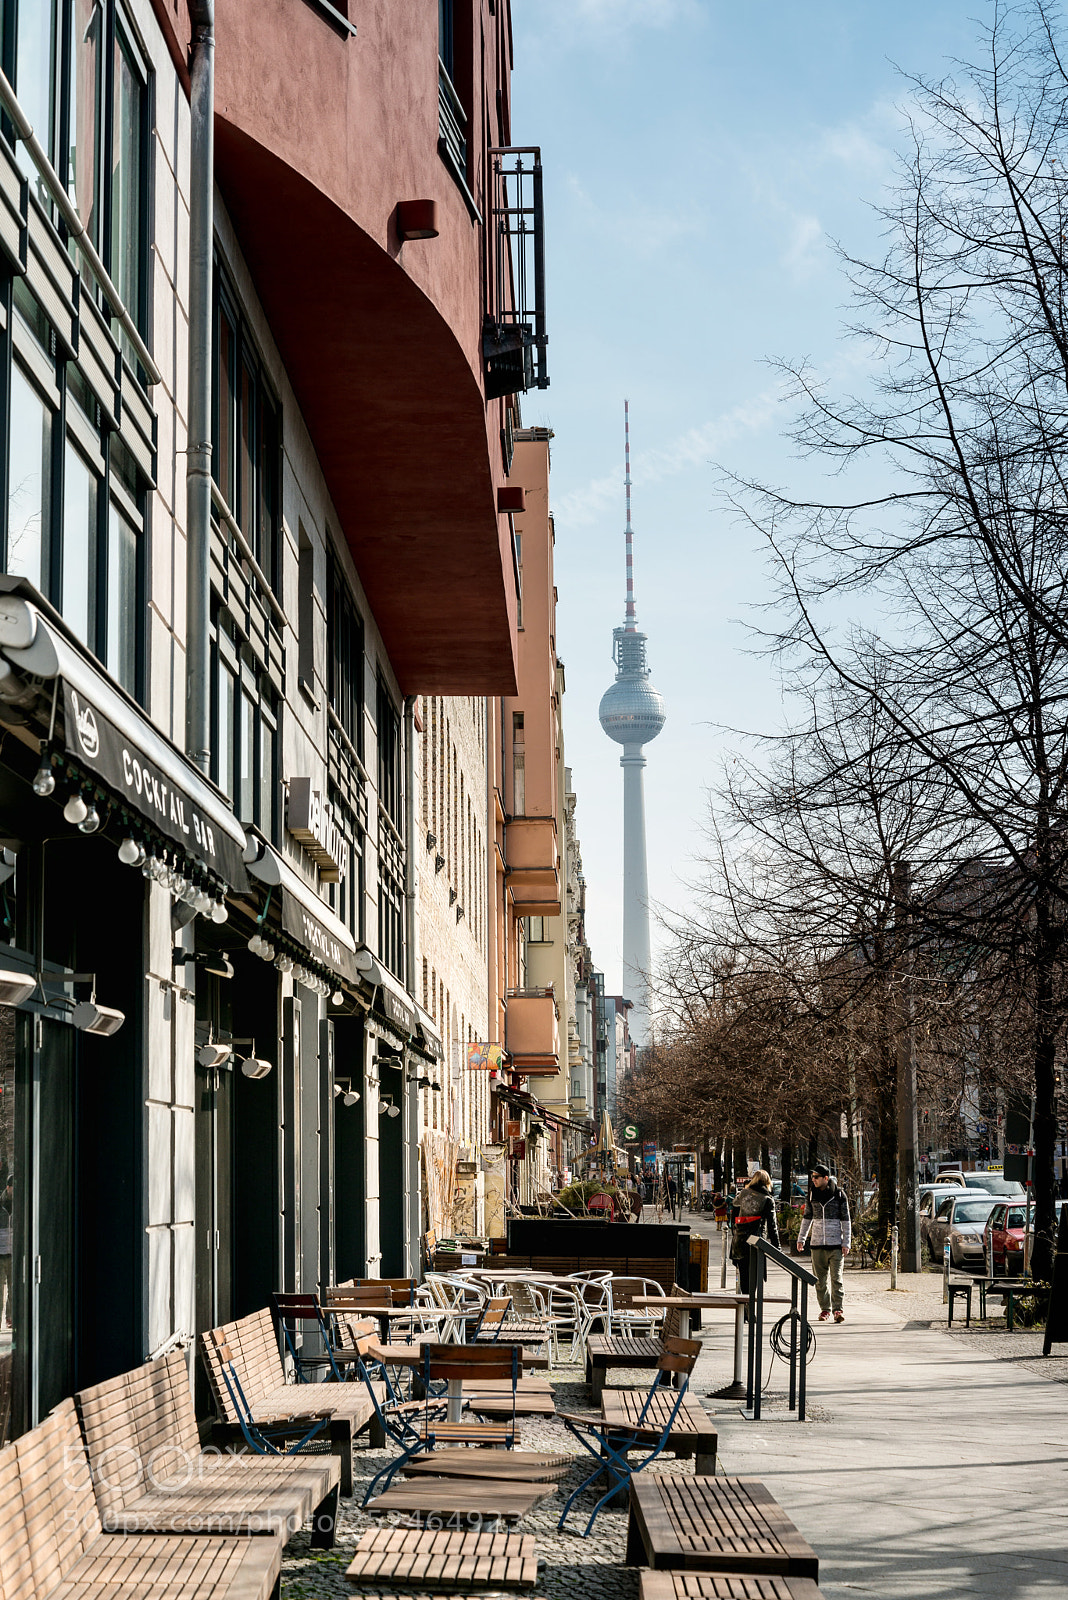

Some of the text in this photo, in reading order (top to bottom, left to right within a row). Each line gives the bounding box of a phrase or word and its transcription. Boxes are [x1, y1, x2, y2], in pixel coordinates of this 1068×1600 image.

[122, 749, 216, 857] COCKTAIL BAR
[624, 1125, 637, 1140] S
